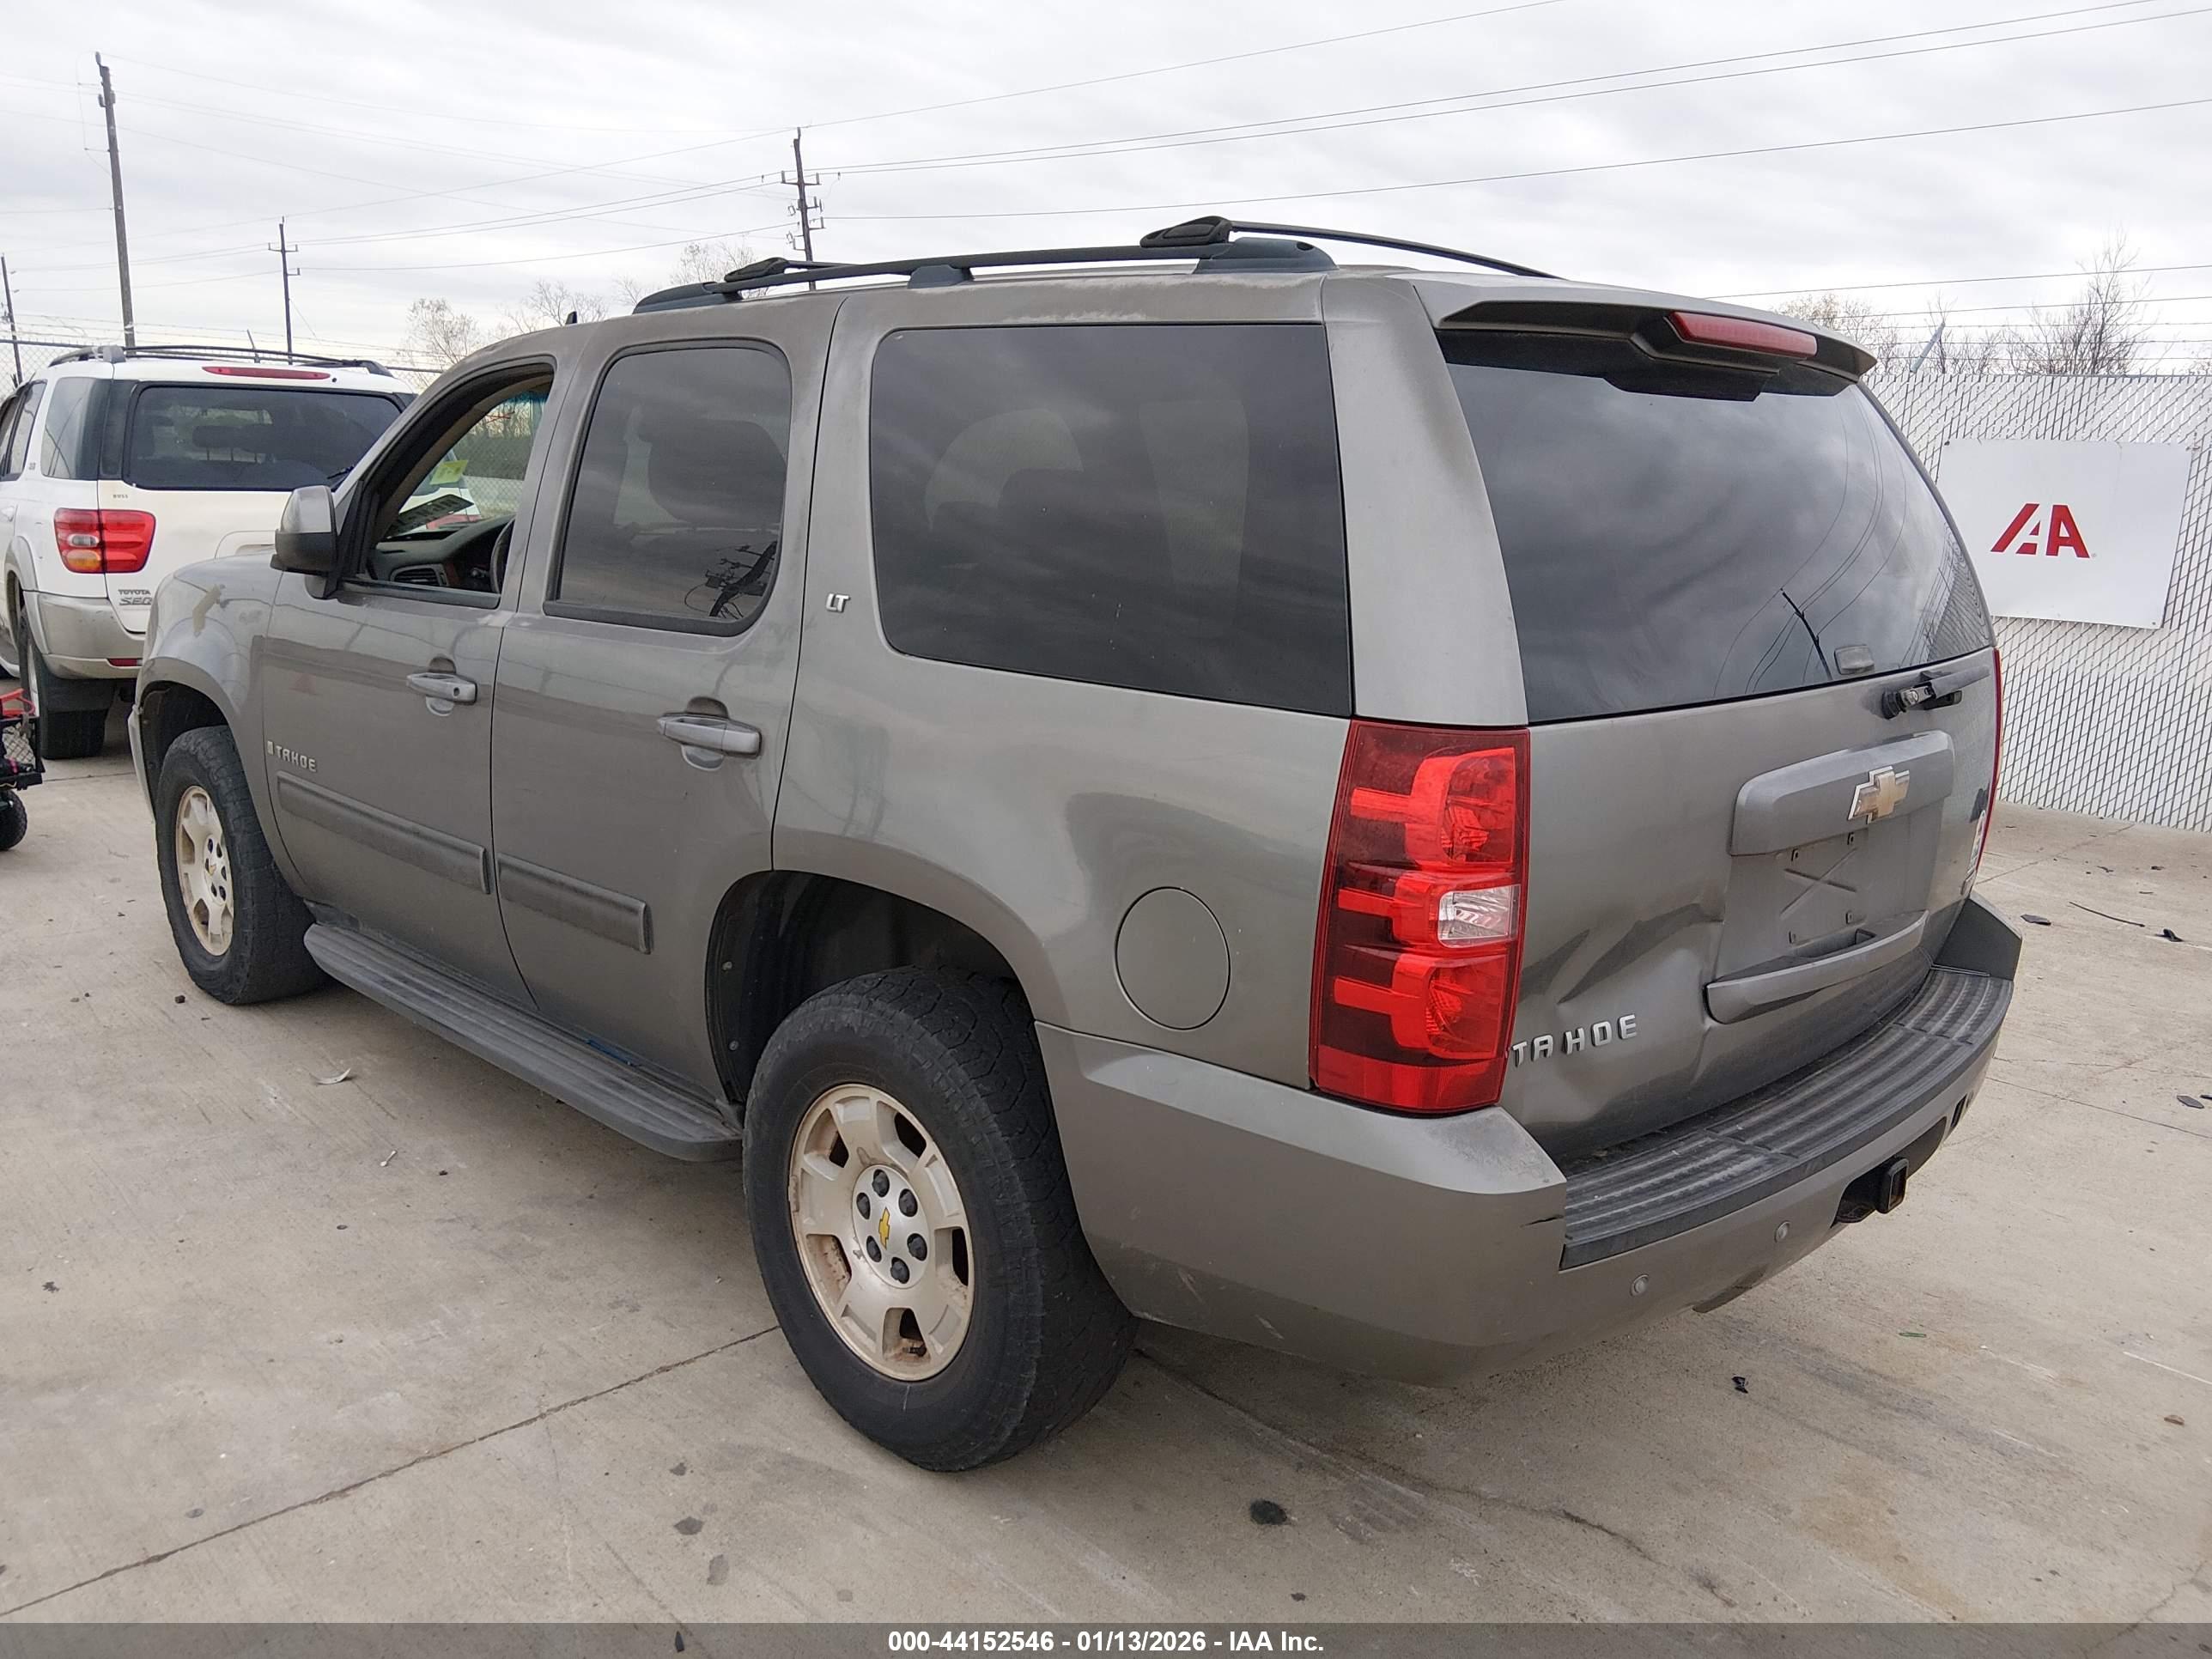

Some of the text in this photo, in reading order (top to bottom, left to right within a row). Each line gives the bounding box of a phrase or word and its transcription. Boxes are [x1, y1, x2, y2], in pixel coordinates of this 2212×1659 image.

[826, 593, 849, 612] LT
[276, 744, 317, 773] TAHOE
[1512, 1014, 1638, 1068] TAHOE
